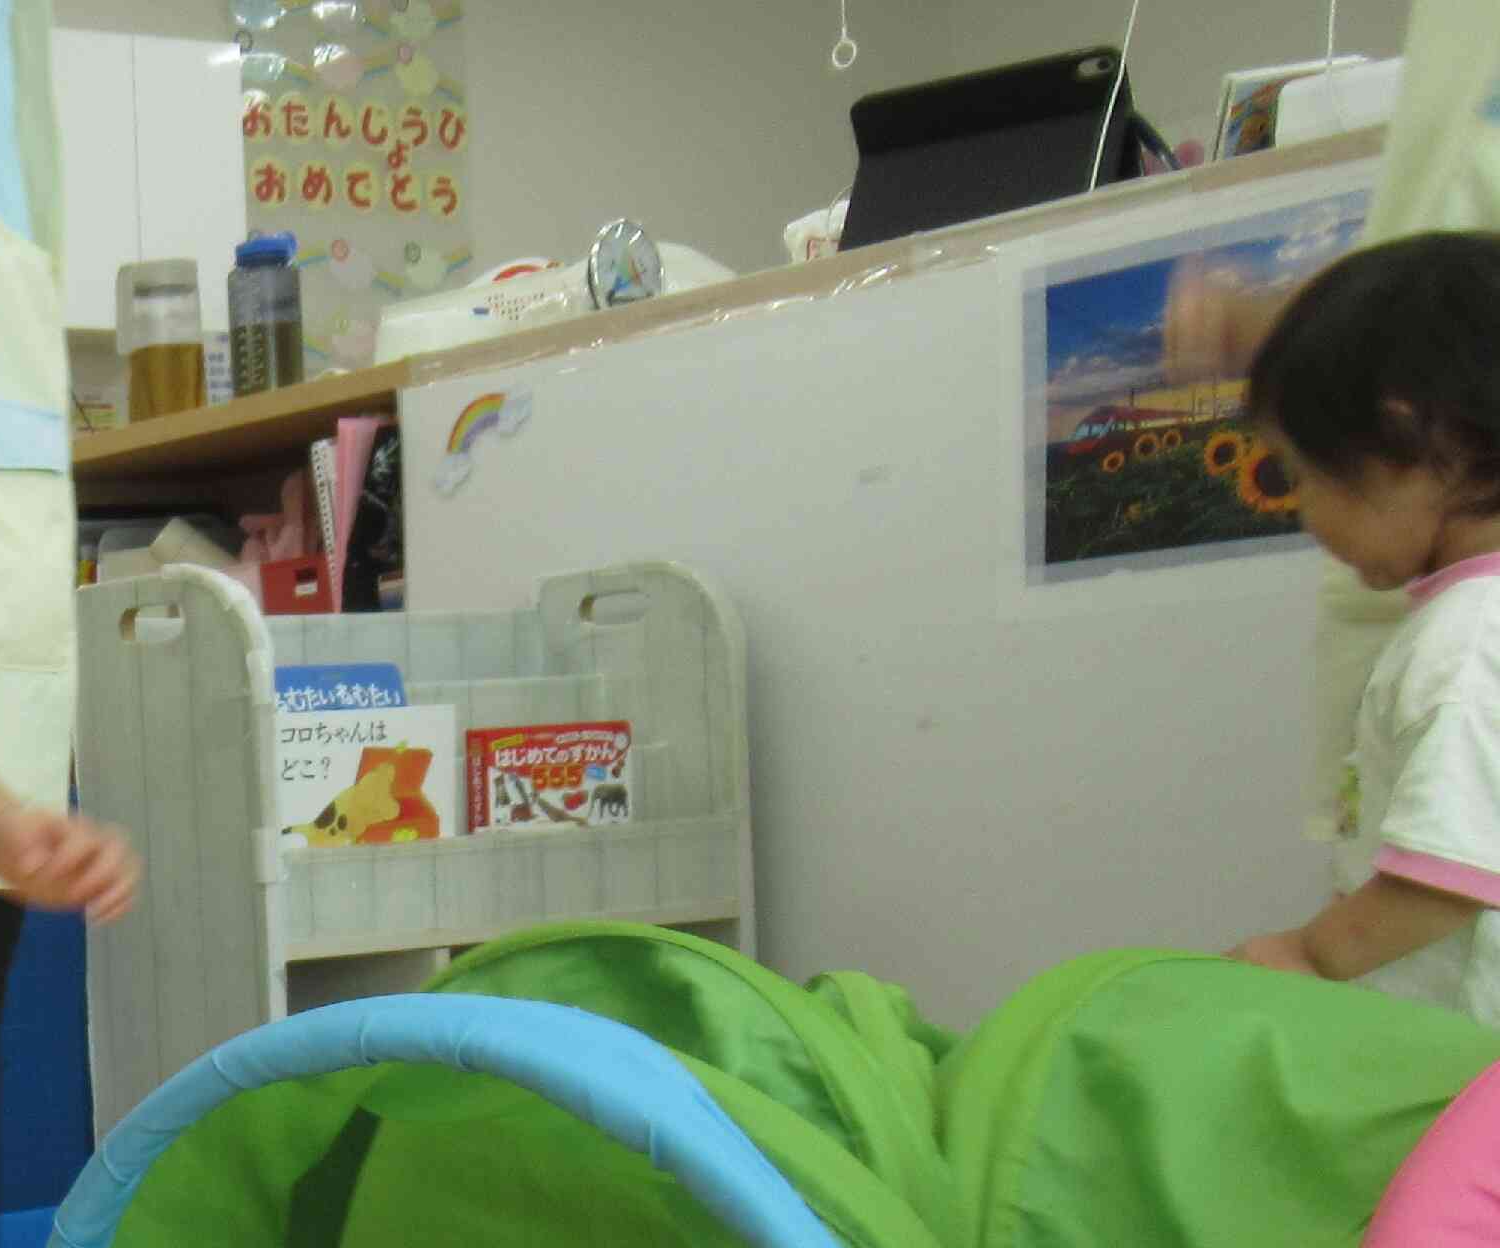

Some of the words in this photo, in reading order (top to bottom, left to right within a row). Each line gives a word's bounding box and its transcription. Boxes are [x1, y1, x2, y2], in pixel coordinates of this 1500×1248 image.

[281, 720, 388, 745] コロちゃんは
